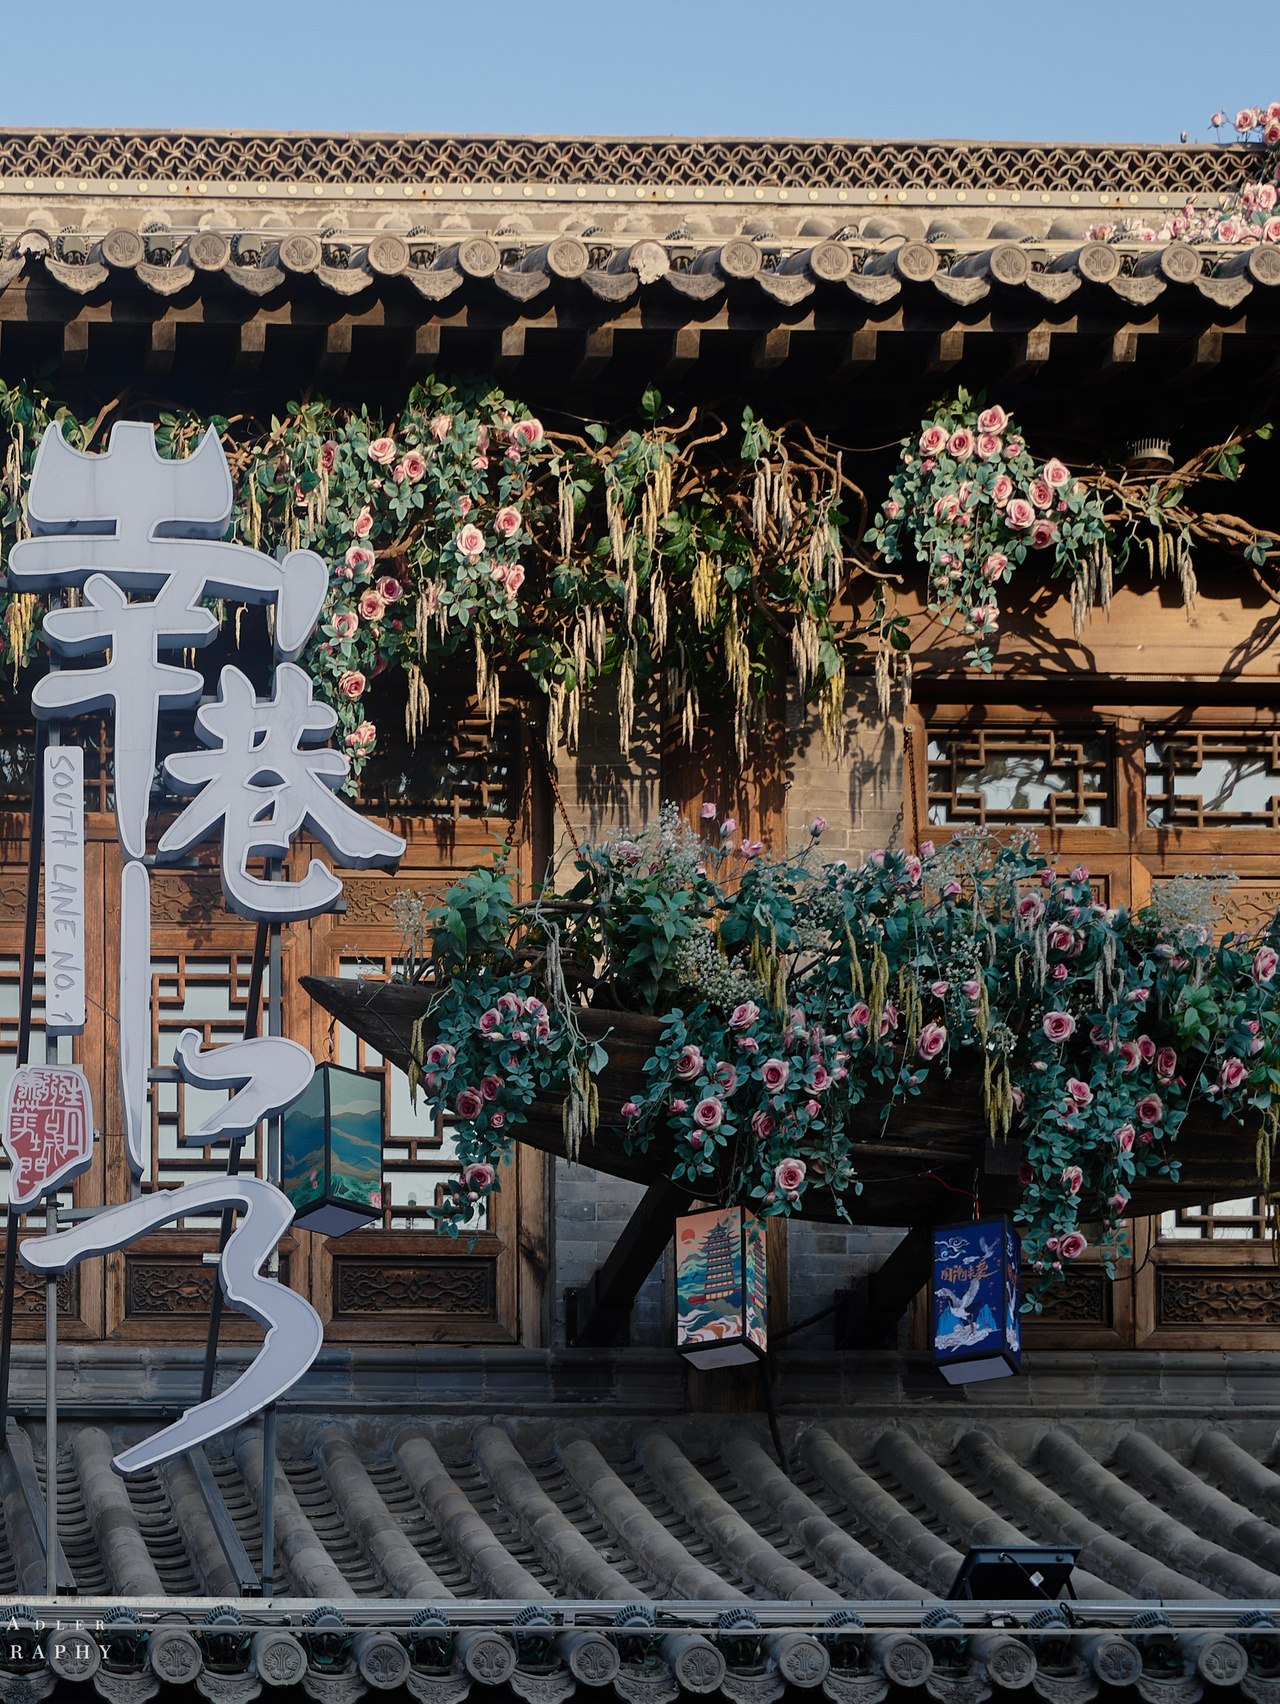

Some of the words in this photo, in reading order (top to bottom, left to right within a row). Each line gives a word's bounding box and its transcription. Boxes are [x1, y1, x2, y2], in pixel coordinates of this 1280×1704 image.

[49, 755, 79, 848] SOUTH
[49, 863, 82, 938] LANE
[51, 950, 82, 998] NO.
[51, 1010, 74, 1023] 1
